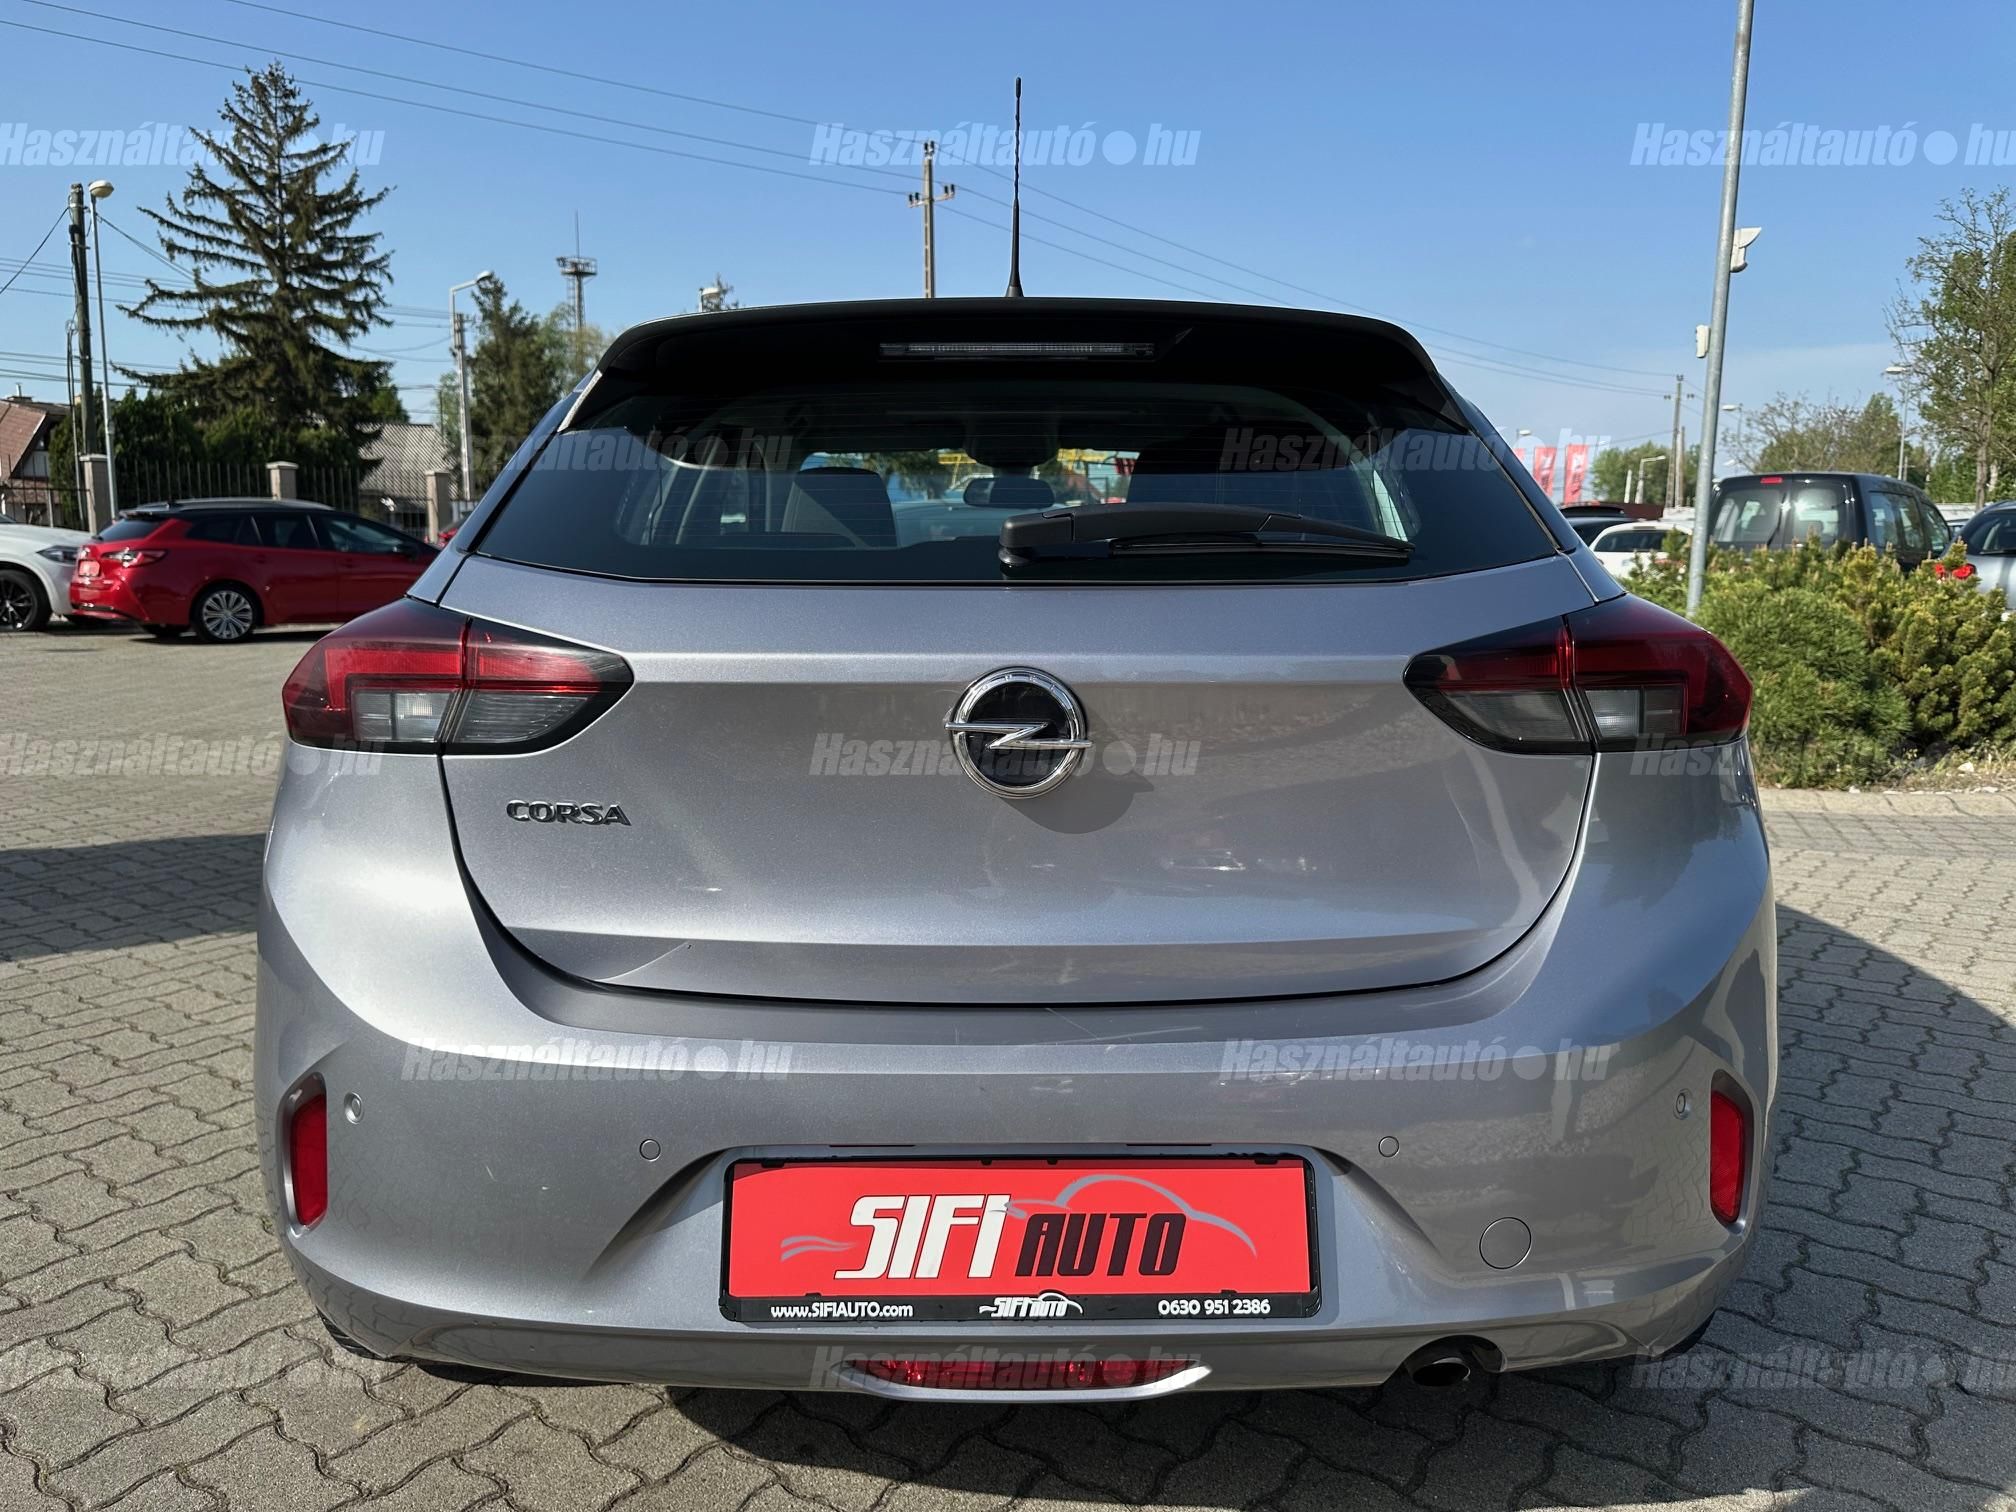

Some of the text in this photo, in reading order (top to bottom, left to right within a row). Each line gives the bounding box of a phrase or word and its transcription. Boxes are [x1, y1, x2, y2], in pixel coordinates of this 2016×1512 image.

[506, 799, 632, 826] CORSA
[833, 1193, 1187, 1280] SIFI AUTO
[770, 1301, 914, 1318] www.SIFIAUTO.com
[1158, 1298, 1271, 1315] 0630 951 2386
